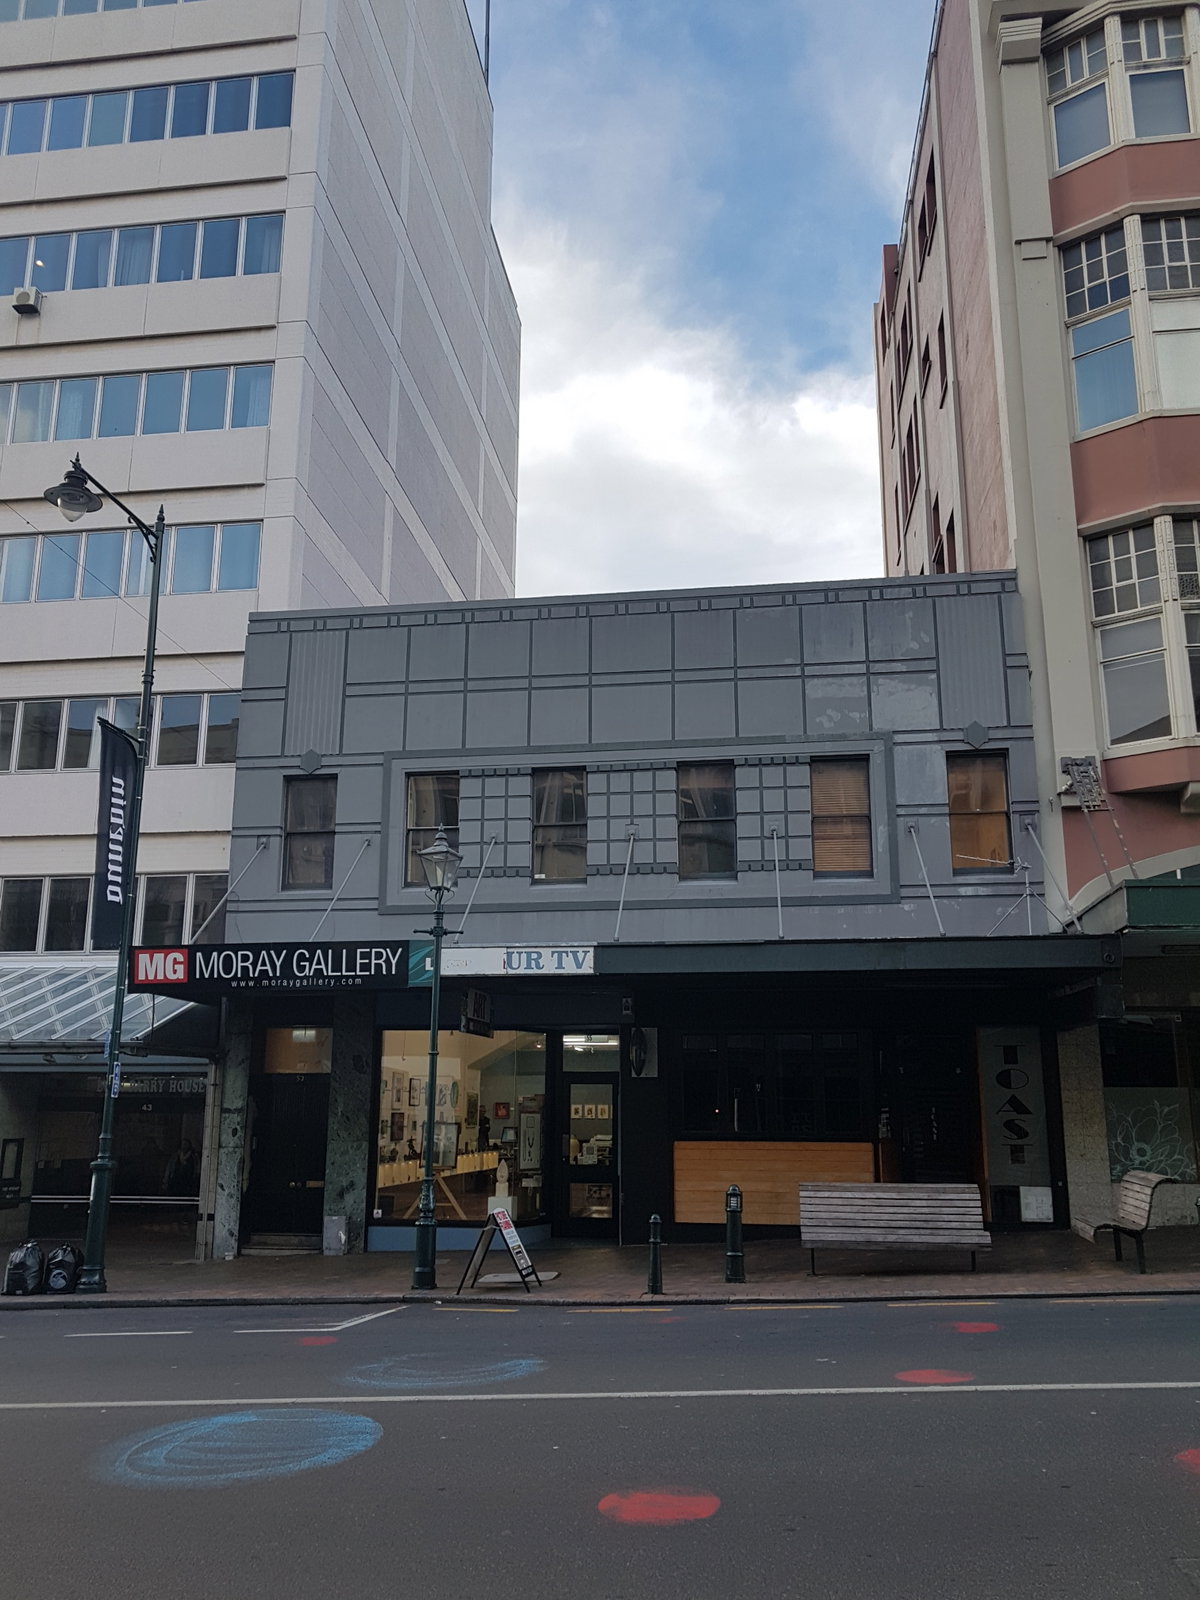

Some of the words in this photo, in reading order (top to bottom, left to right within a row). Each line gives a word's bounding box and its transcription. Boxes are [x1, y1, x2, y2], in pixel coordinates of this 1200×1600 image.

[138, 952, 184, 980] MG
[195, 949, 287, 979] MORAY
[292, 947, 403, 977] GALLERY
[551, 950, 590, 970] TV
[231, 977, 362, 989] www.moraygallery.com
[169, 1079, 206, 1093] HOUSE
[993, 1044, 1033, 1165] TOAST
